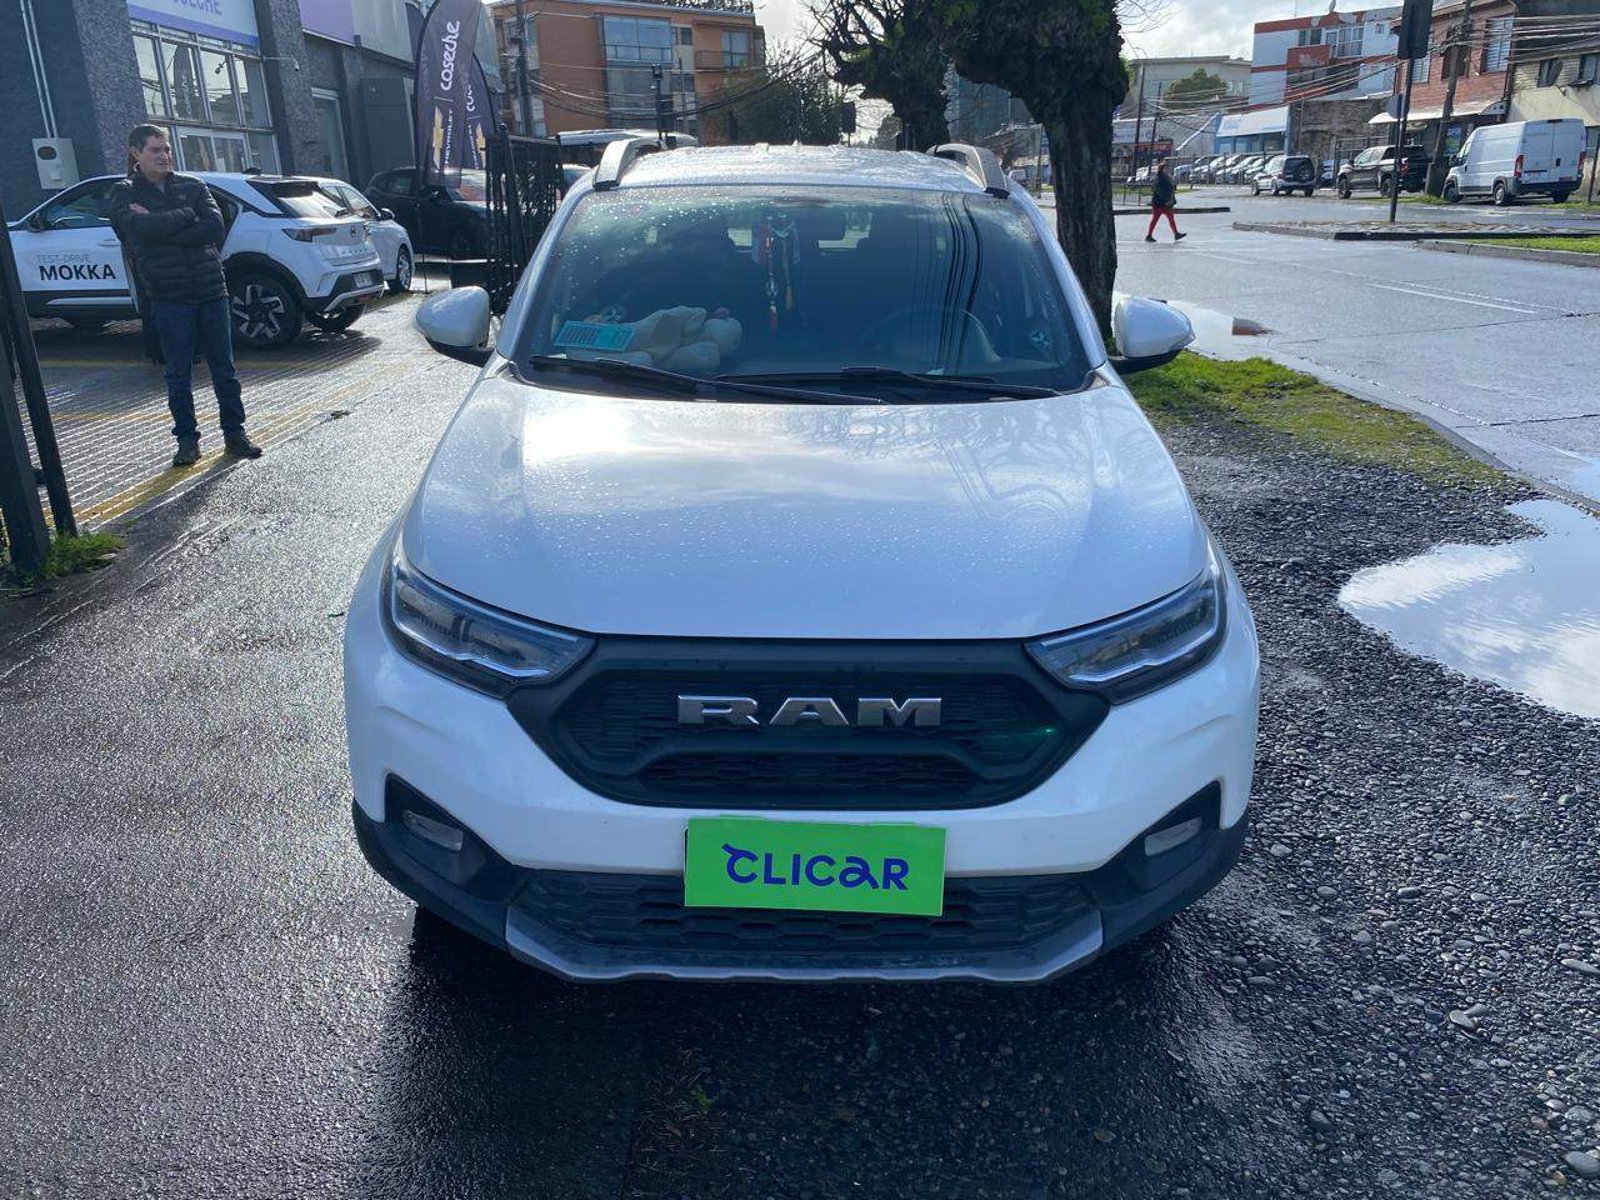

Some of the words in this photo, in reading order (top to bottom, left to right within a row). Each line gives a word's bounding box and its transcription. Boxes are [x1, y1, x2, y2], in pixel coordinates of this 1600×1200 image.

[440, 20, 460, 91] coseche
[39, 264, 116, 280] MOKKA
[678, 695, 942, 727] RAM
